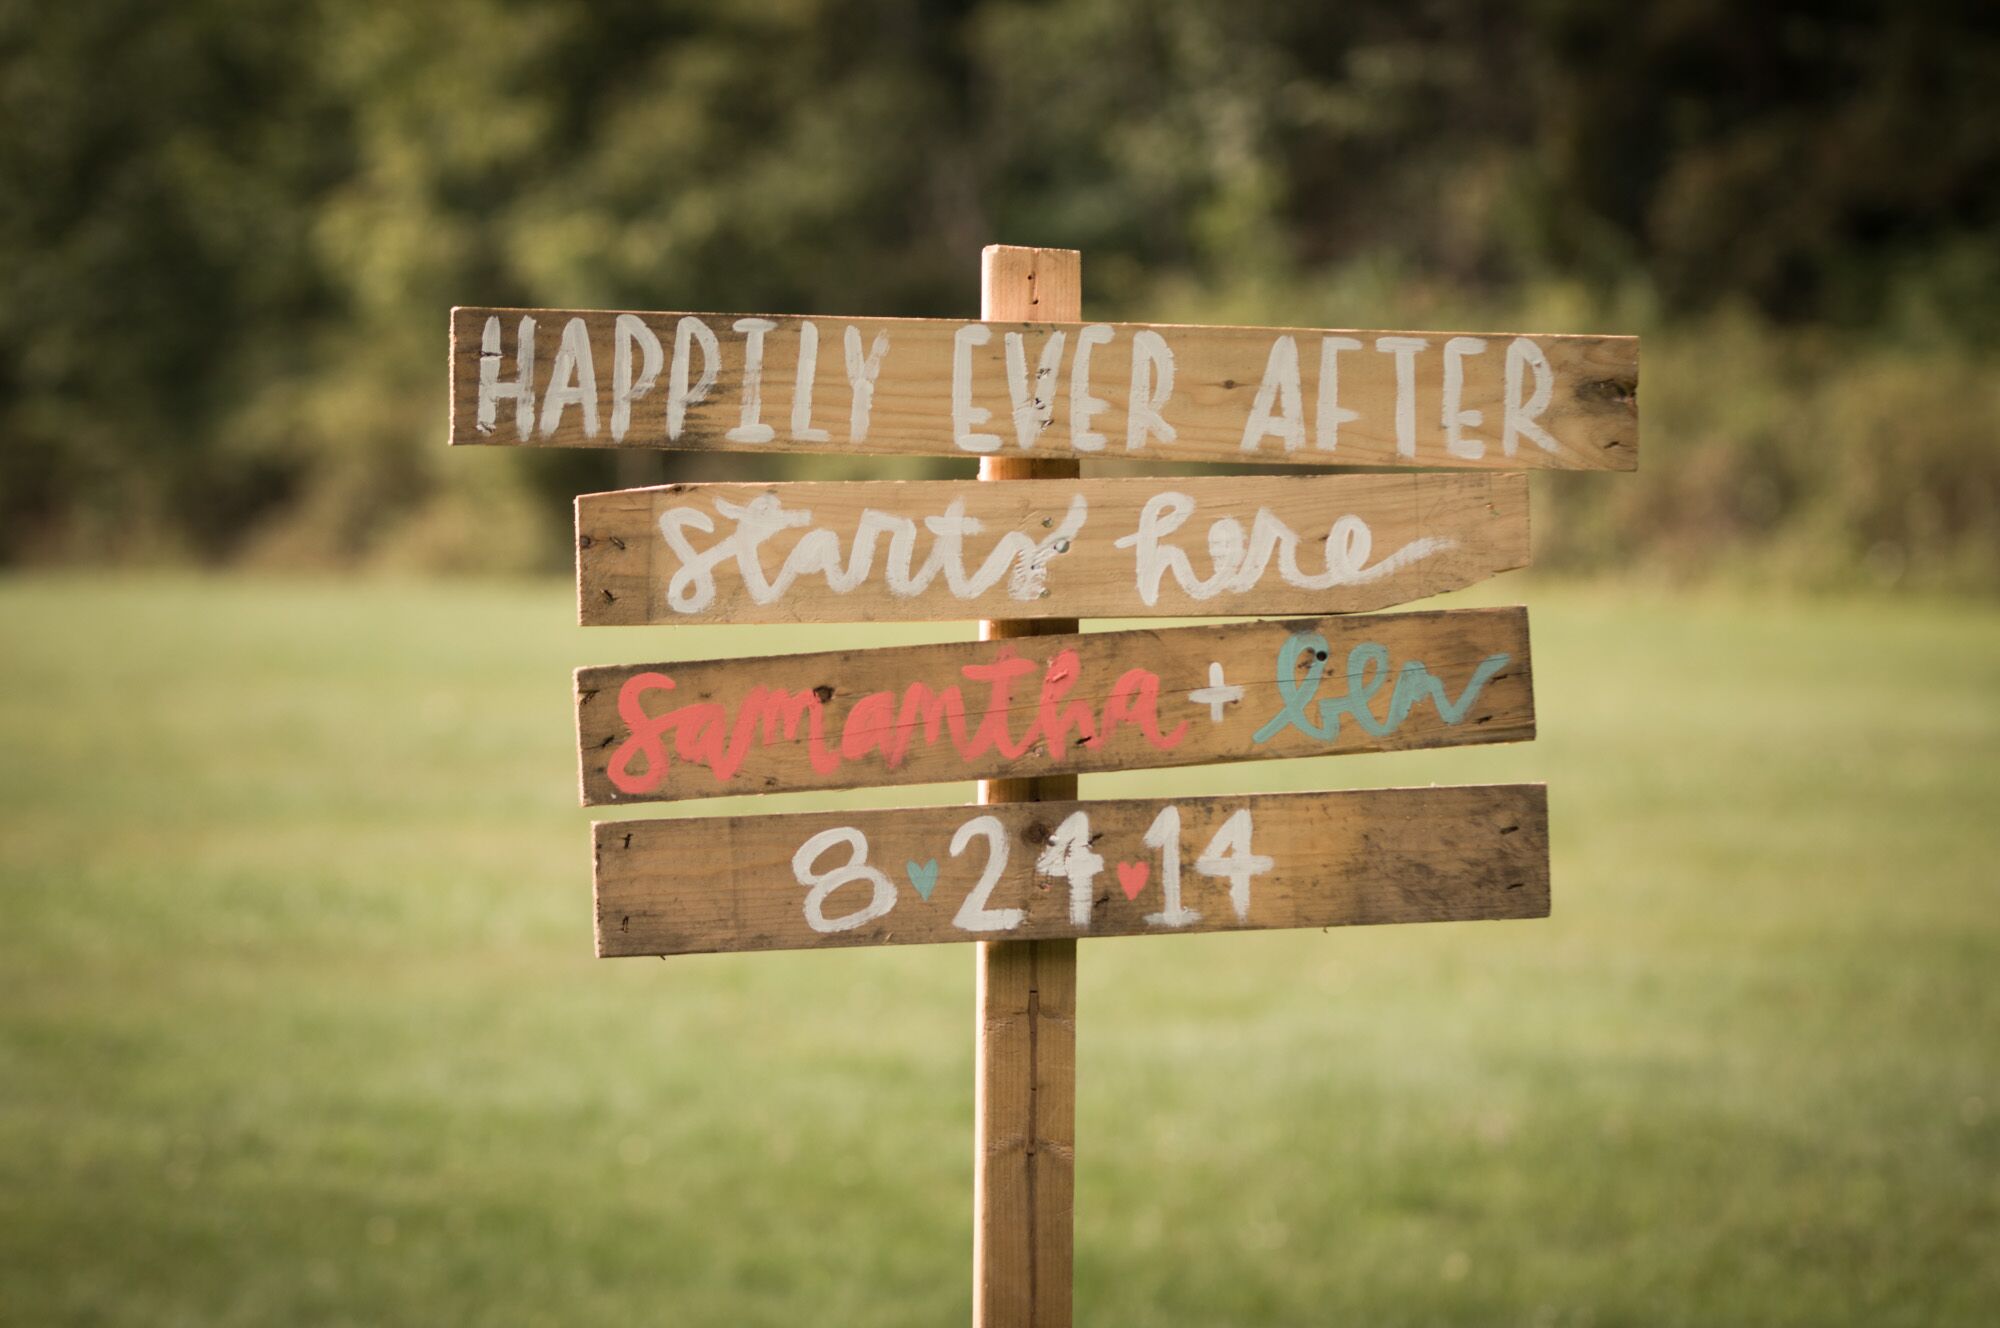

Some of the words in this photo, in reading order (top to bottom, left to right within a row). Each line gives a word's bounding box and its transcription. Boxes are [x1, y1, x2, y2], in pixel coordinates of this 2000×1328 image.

[477, 314, 889, 443] HAPPILY
[952, 323, 1178, 452] EVER
[1241, 334, 1567, 459] AFTER
[1114, 492, 1459, 606] here
